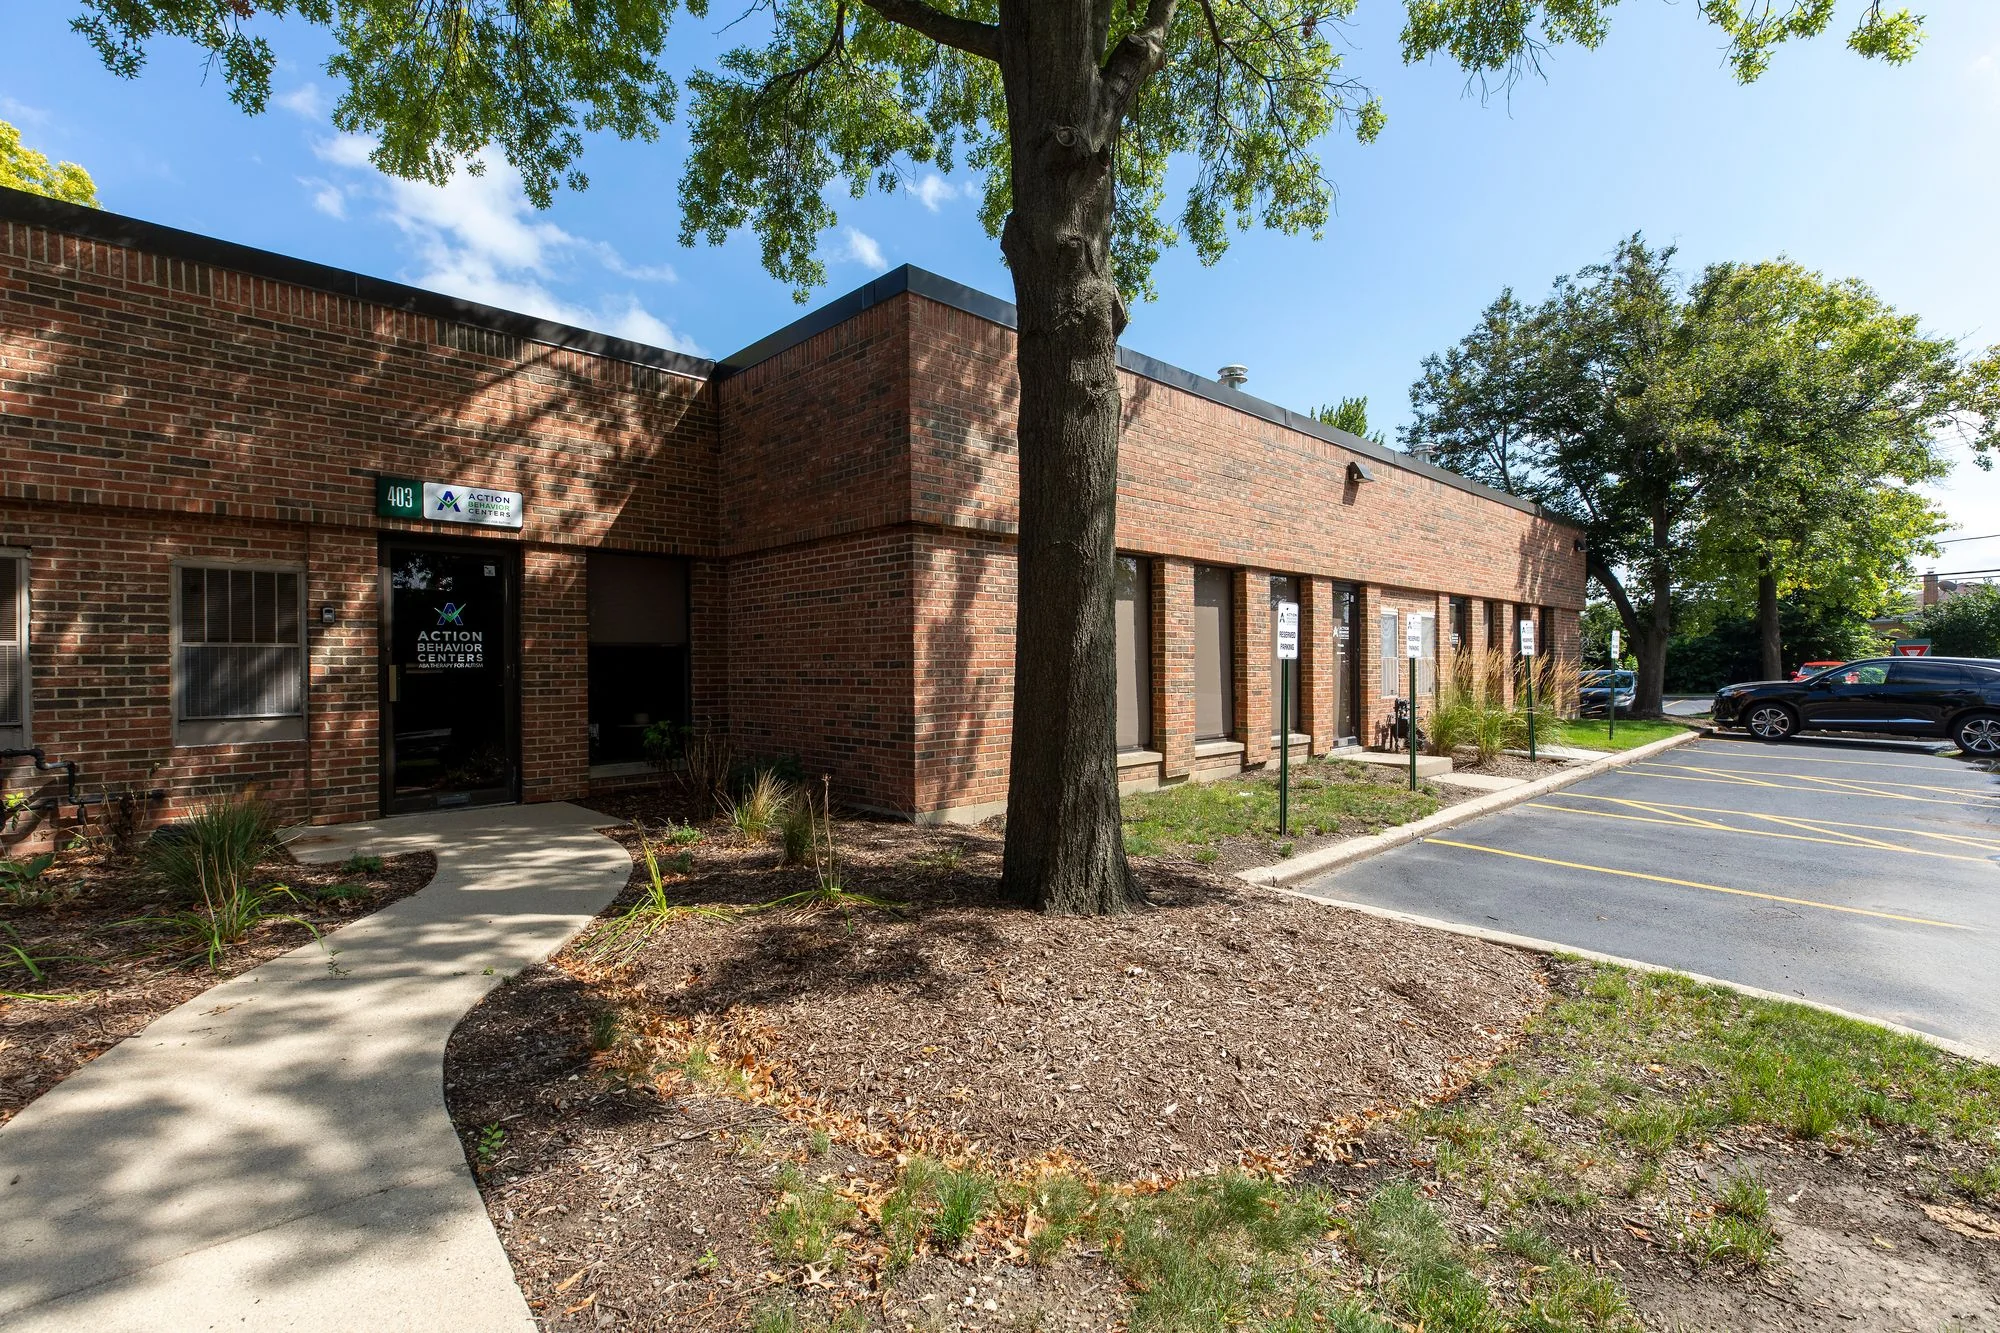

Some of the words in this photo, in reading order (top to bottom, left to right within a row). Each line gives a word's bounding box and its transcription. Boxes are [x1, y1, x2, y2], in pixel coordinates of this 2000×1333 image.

[387, 486, 413, 508] 403
[468, 493, 510, 504] ACTION
[468, 500, 510, 511] BEHAVIOR
[468, 509, 511, 518] CENTERS
[417, 631, 483, 642] ACTION
[1279, 631, 1296, 639] RESERVED
[417, 643, 483, 652] BEHAVIOR
[417, 654, 484, 662] CENTERS
